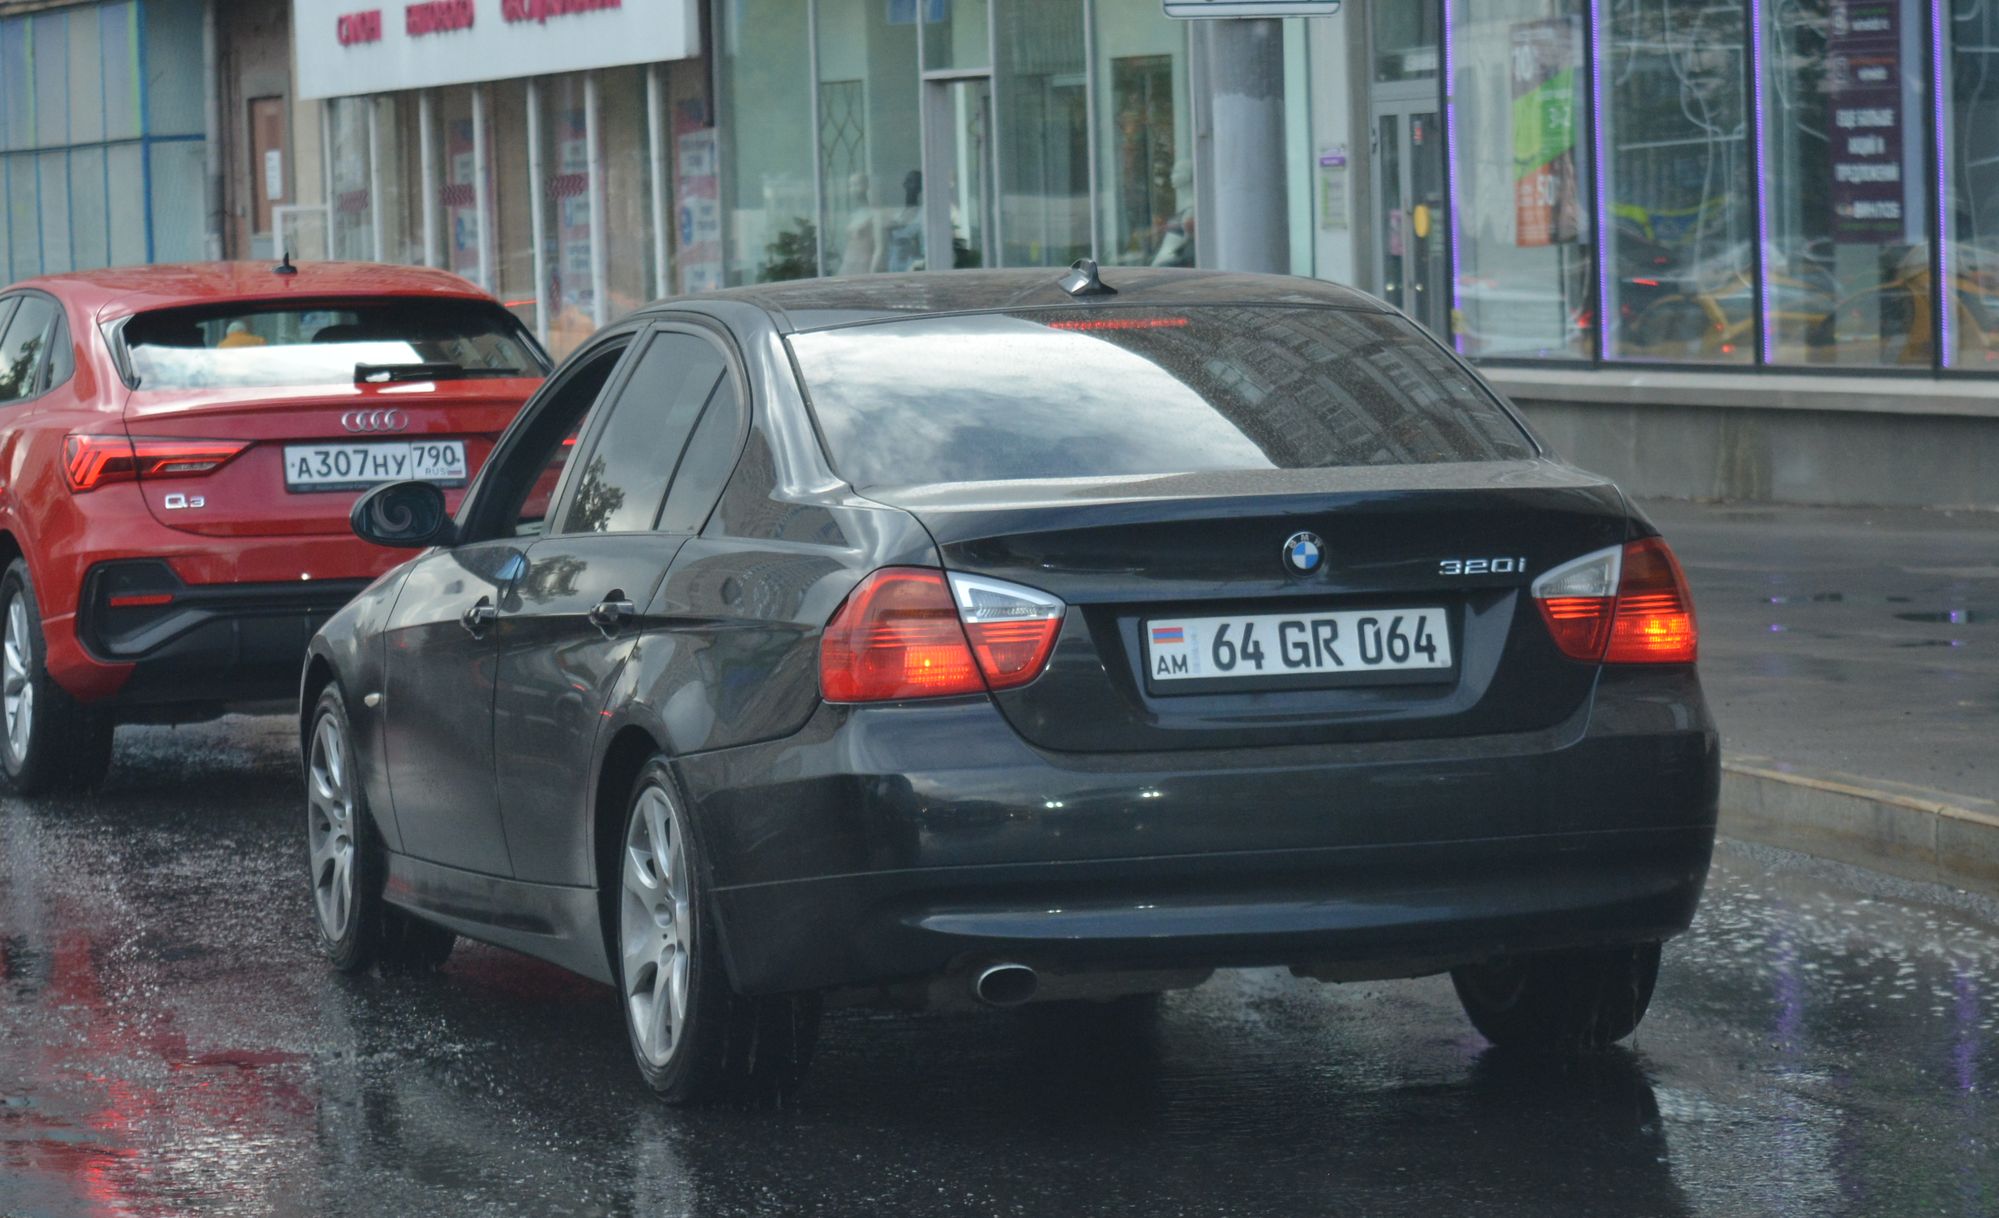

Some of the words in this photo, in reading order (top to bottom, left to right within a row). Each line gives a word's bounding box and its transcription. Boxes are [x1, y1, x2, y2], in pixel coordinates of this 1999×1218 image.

[297, 449, 407, 479] А307НУ
[413, 445, 456, 468] 790
[425, 467, 447, 476] RUS
[165, 494, 205, 509] Q3
[1288, 534, 1323, 549] BMW
[1439, 558, 1526, 575] 320i
[1156, 655, 1188, 675] AM
[1212, 622, 1265, 671] 64
[1278, 619, 1344, 669] GR
[1356, 615, 1437, 665] 064
